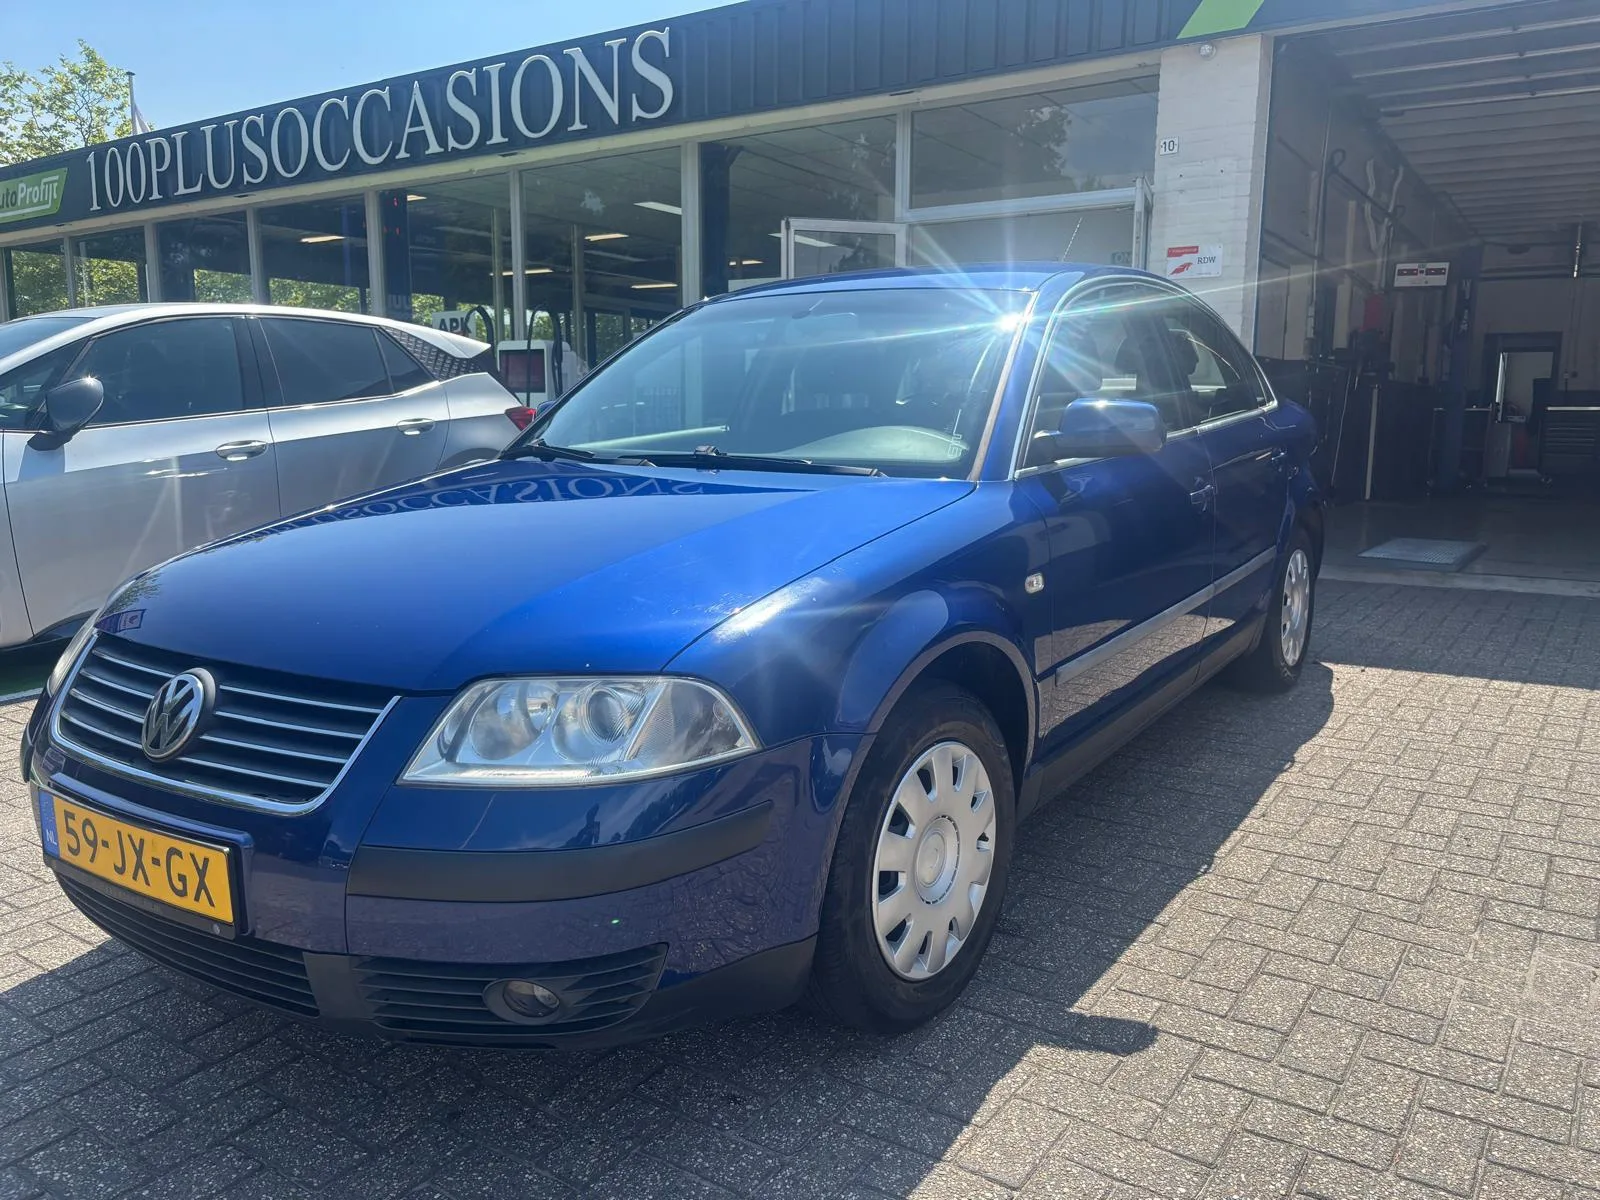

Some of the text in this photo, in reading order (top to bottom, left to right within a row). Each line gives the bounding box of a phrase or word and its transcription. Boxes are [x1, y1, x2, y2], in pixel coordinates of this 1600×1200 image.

[86, 26, 674, 212] 100PLUSOCCASIONS
[0, 175, 60, 209] utoProfijt
[1197, 256, 1216, 265] RDW
[439, 316, 472, 334] APK
[45, 829, 58, 846] NL
[63, 808, 216, 909] 59-JX-GX
